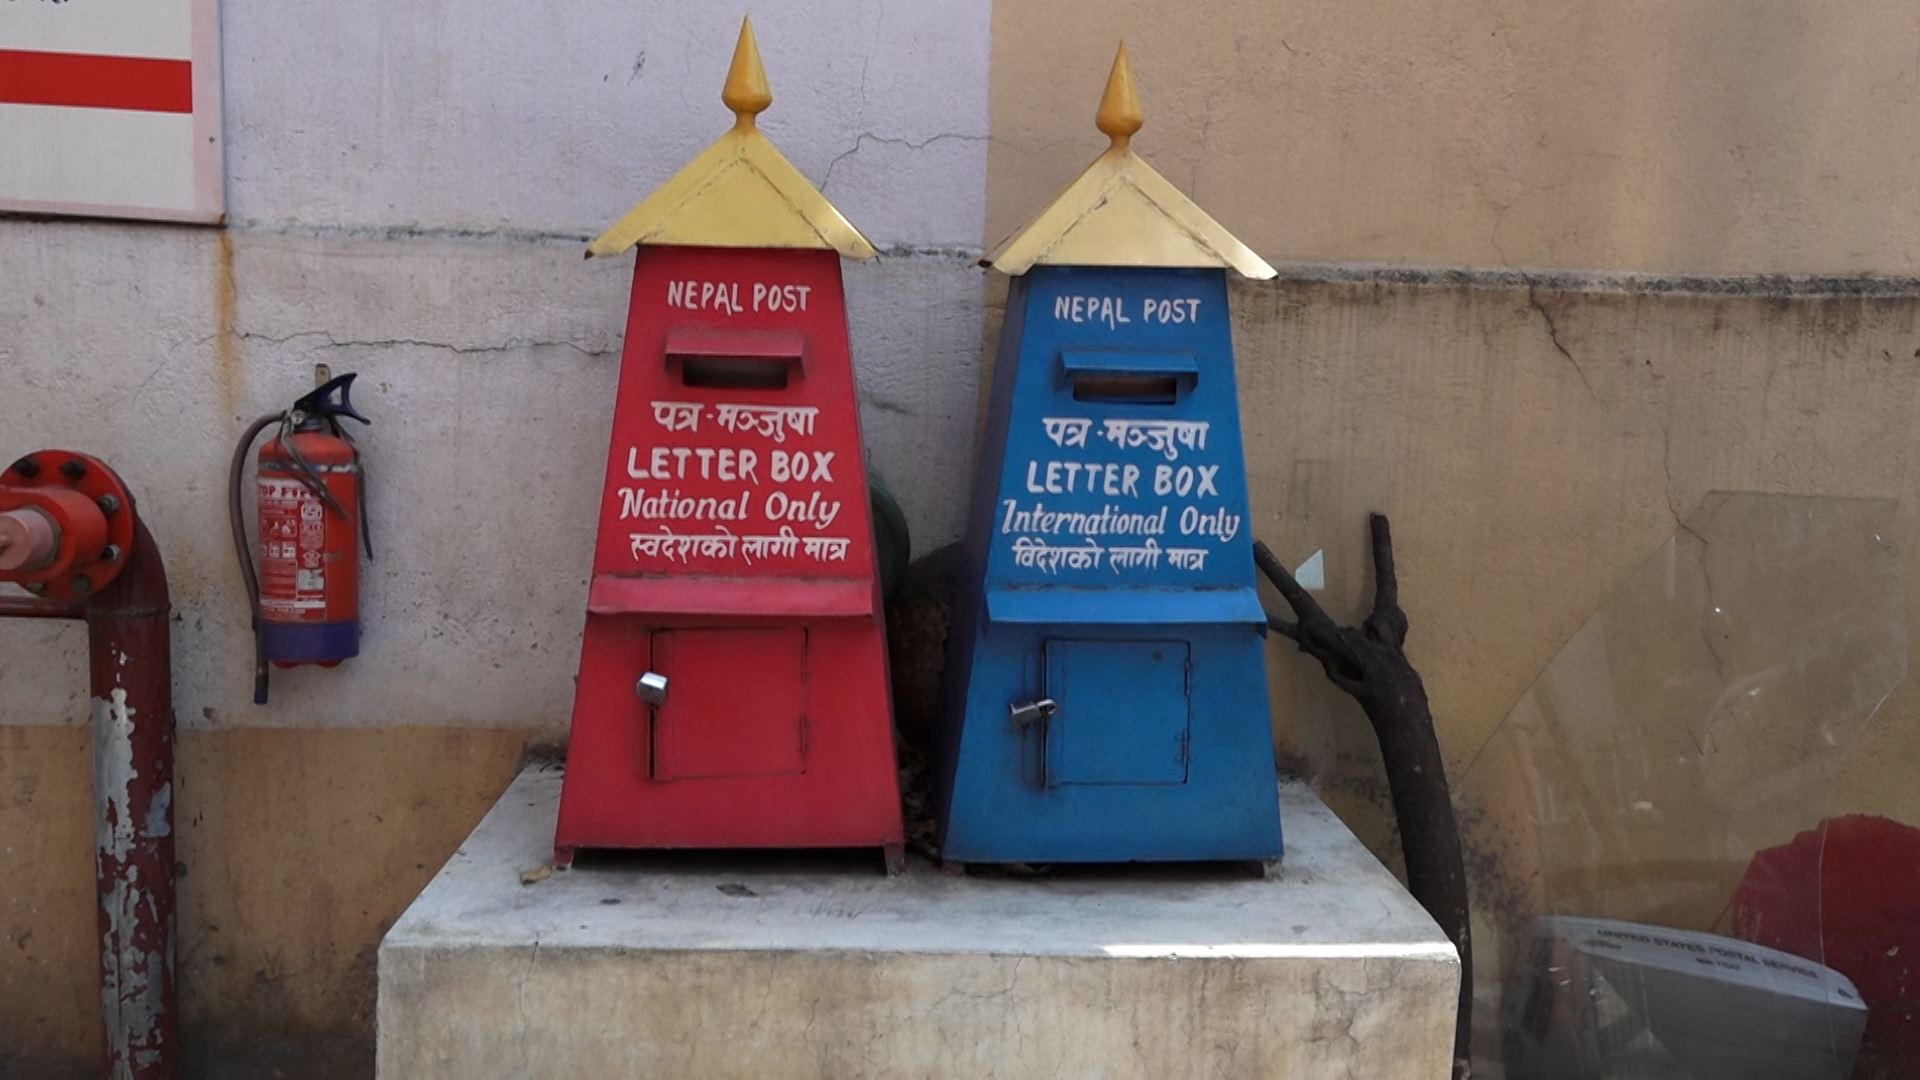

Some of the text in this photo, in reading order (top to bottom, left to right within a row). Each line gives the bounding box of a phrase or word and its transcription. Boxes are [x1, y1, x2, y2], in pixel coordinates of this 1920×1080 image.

[667, 280, 811, 316] NEPAL POST
[1054, 296, 1202, 331] NEPAL POST
[627, 446, 835, 485] LETTER BOX
[1026, 460, 1220, 499] LETTER BOX
[617, 487, 841, 530] National Only
[1001, 498, 1241, 542] International Only
[629, 525, 851, 565] स्वदेशको लागी मात्र
[1011, 537, 1210, 576] विदेशको लागी मात्र
[1653, 936, 1705, 953] STATES
